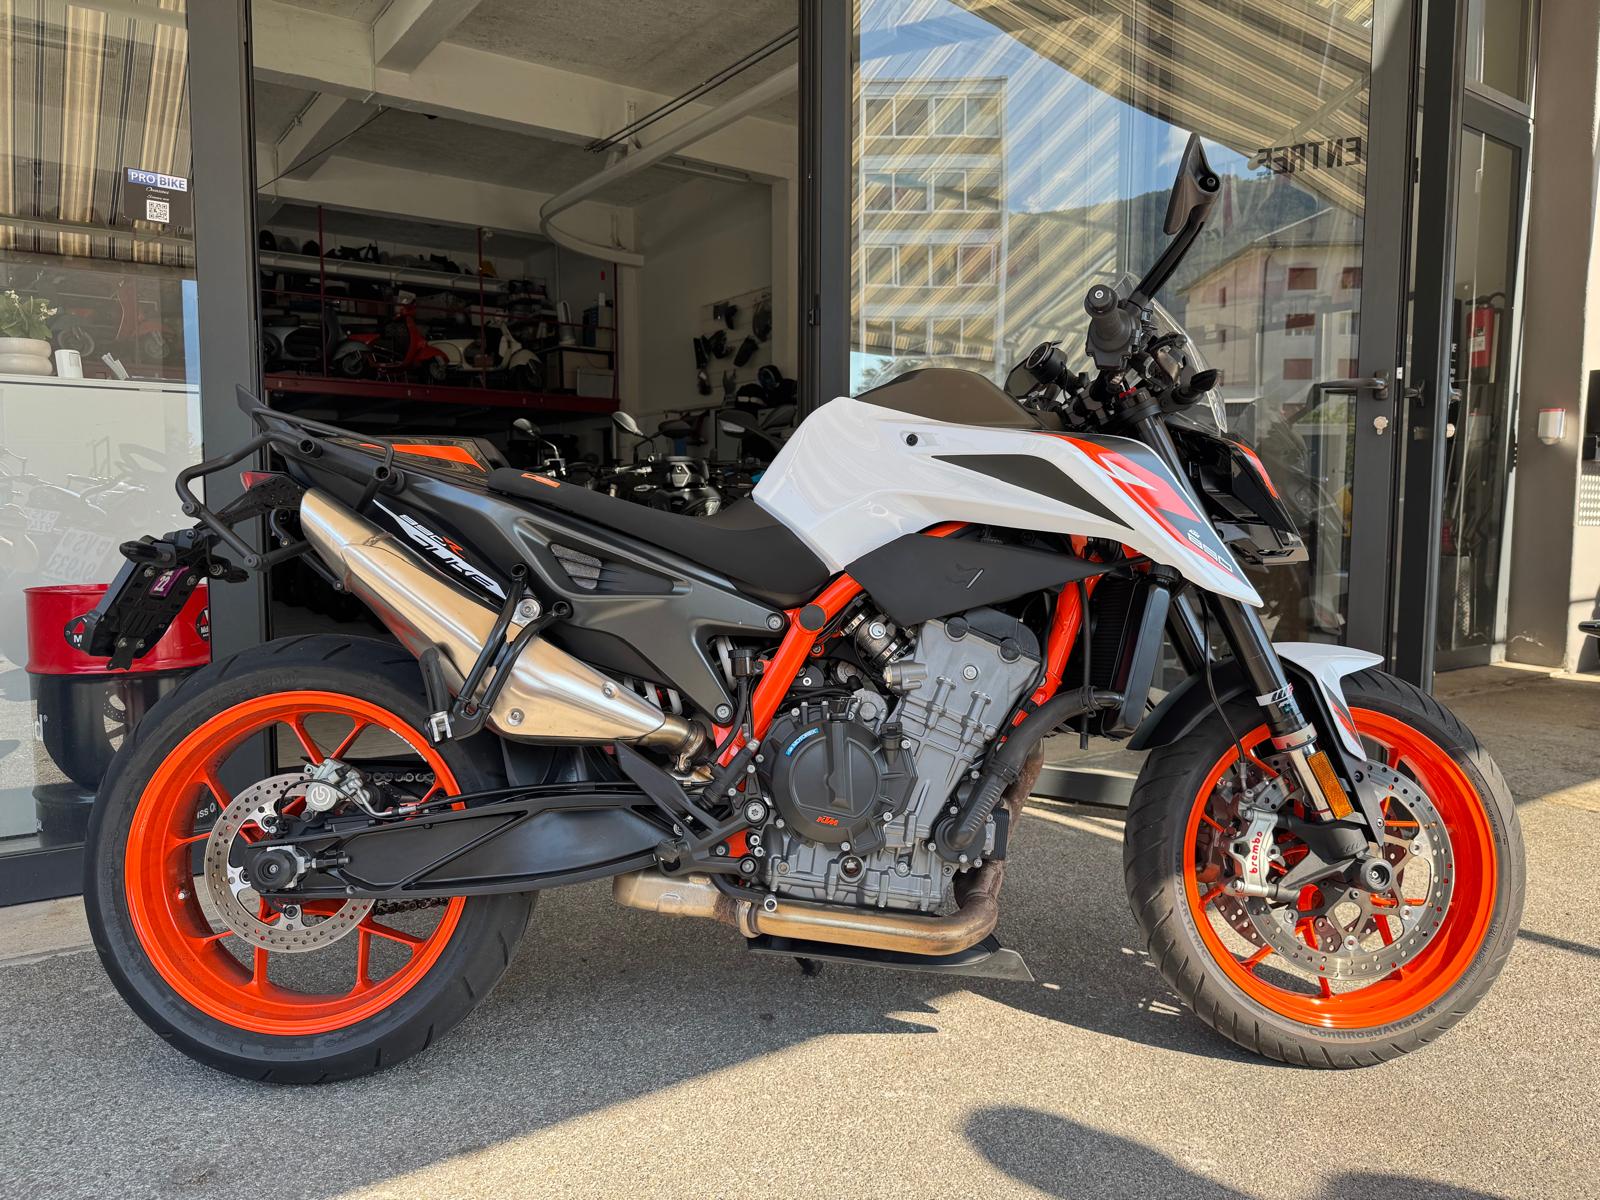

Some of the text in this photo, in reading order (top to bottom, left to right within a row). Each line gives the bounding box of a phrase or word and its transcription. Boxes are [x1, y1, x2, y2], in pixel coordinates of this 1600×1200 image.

[131, 171, 156, 184] PRO
[159, 176, 186, 190] BIKE
[816, 815, 839, 826] KTM
[1249, 831, 1263, 874] brembo
[1309, 1012, 1427, 1039] ContiRoadAttack
